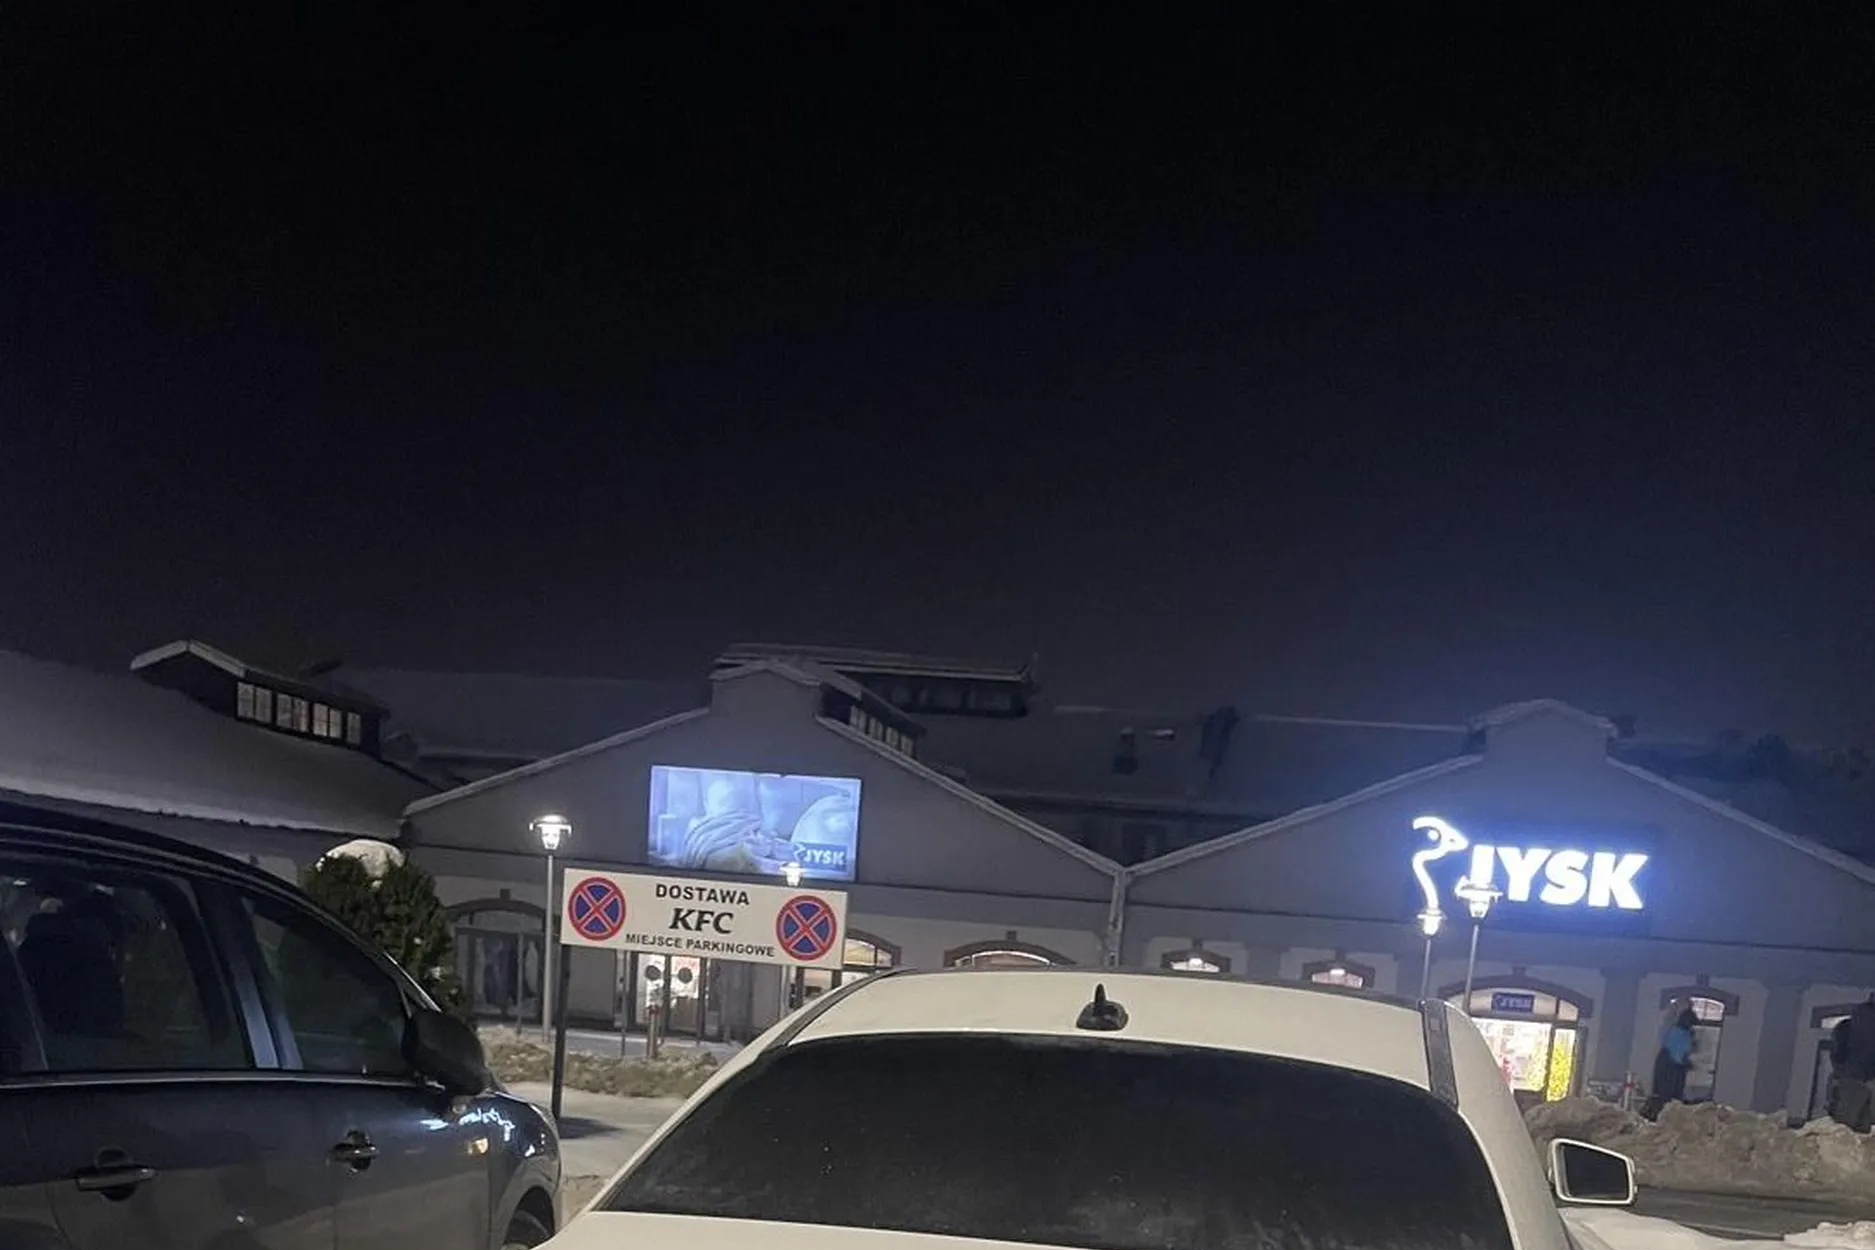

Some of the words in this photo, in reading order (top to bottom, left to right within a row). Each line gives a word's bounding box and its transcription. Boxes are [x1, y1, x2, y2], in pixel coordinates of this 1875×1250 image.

[803, 849, 845, 865] JYSK
[1455, 845, 1648, 910] JYSK
[655, 884, 750, 905] DOSTAWA
[668, 907, 734, 934] KFC
[625, 933, 682, 949] MIEJSCE
[686, 939, 776, 957] PARKINGOWE
